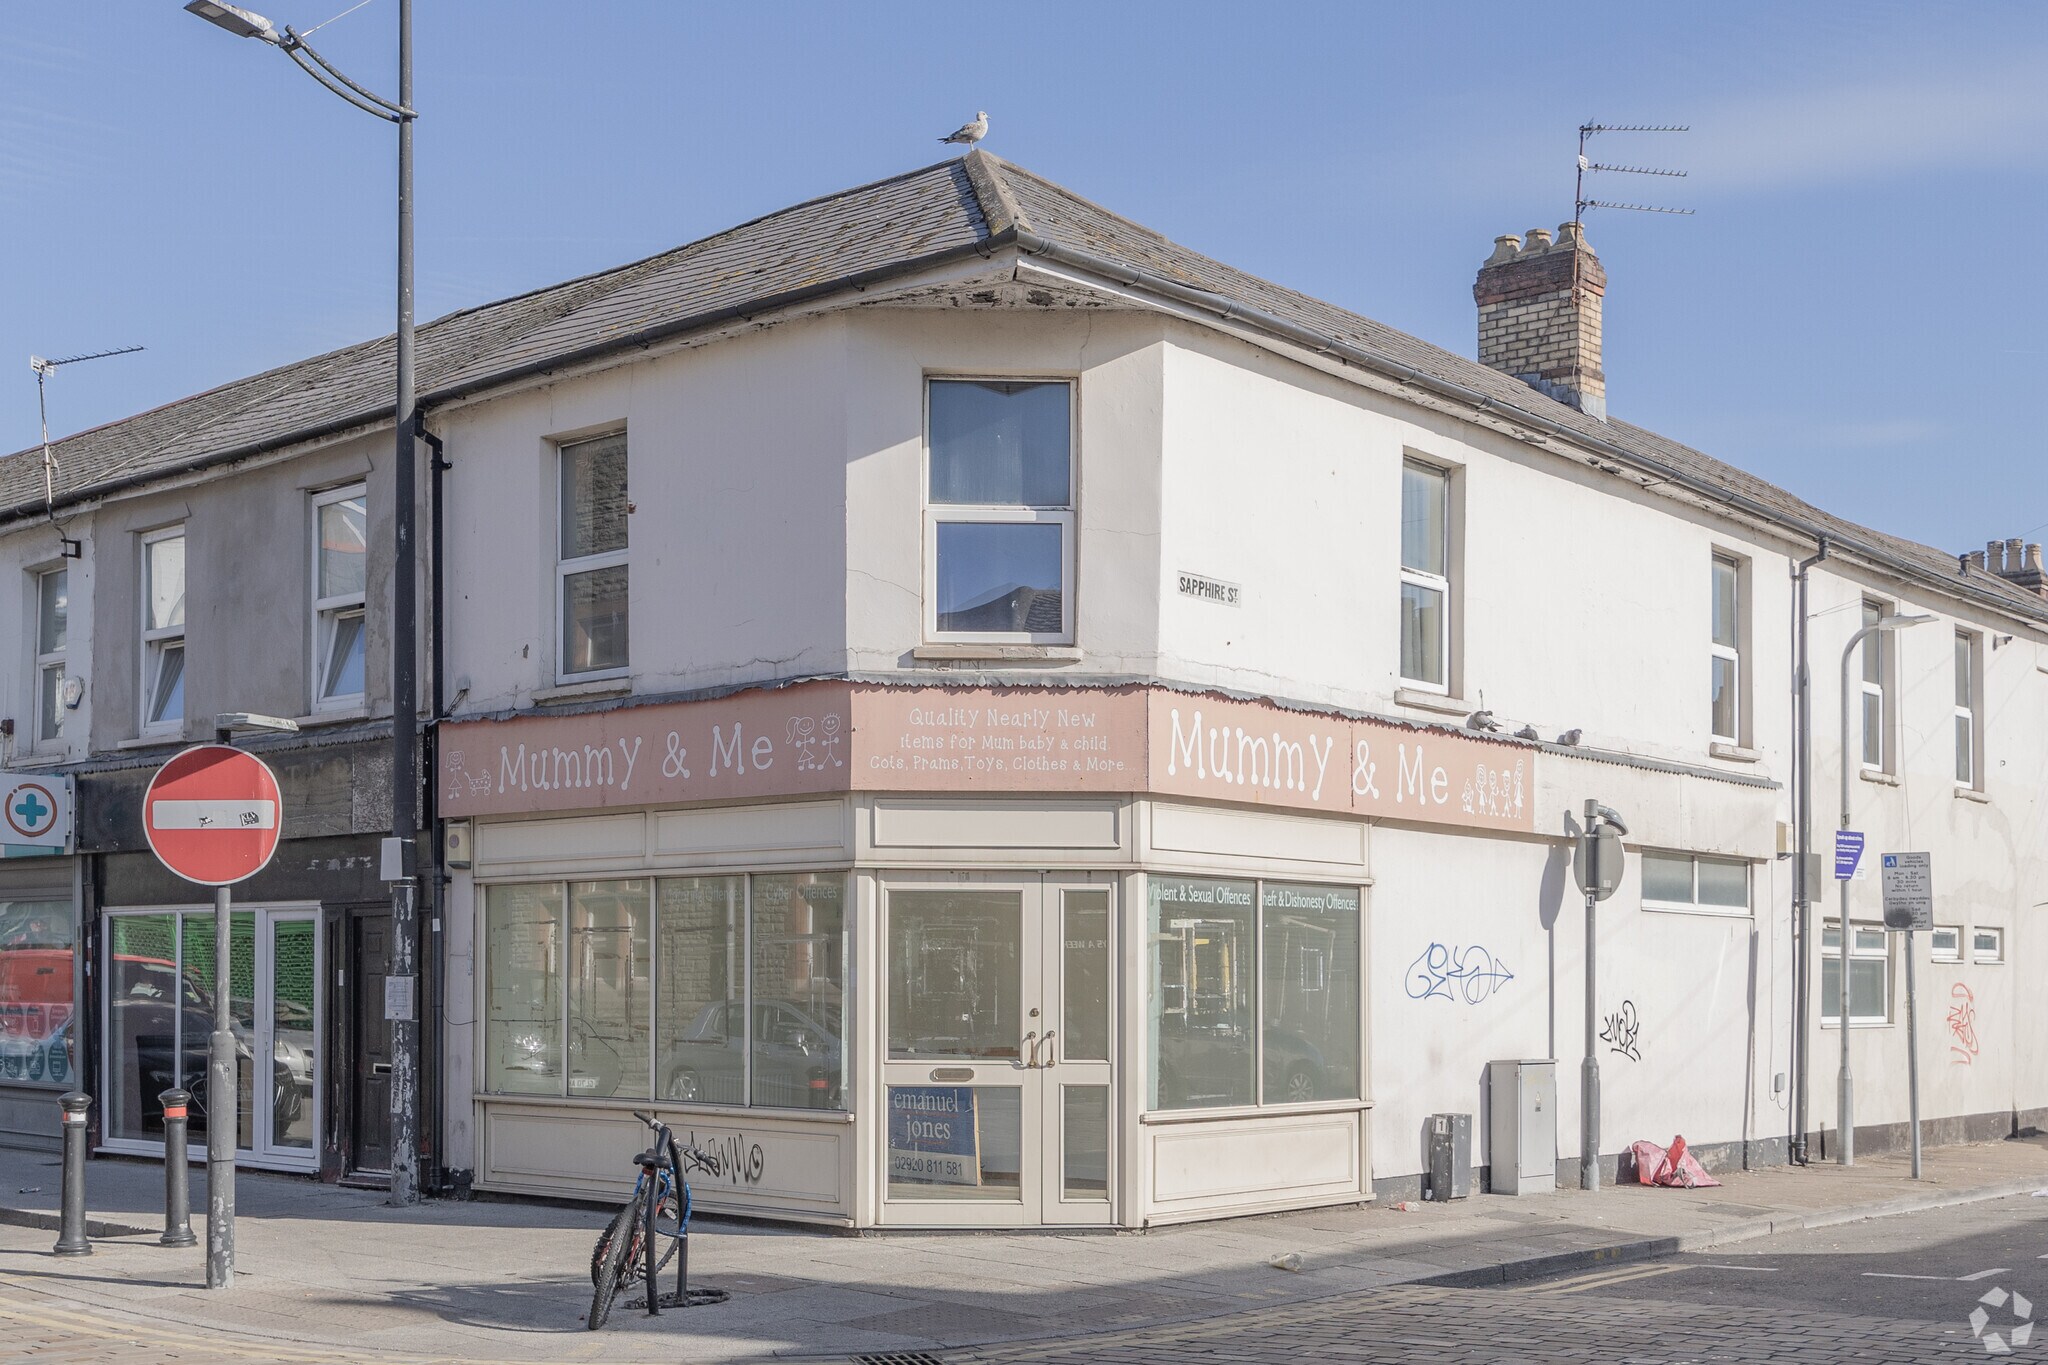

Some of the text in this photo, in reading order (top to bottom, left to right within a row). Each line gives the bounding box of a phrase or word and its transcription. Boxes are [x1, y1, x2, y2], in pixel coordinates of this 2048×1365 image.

[1180, 576, 1225, 602] SAPPHIRE
[909, 707, 1096, 729] Quality Nearly New
[950, 734, 977, 750] for
[981, 735, 1015, 750] Mum
[1019, 735, 1055, 752] baby
[1060, 739, 1069, 750] &
[498, 721, 774, 794] Mummy & Me
[1013, 756, 1068, 771] Clothes
[1073, 760, 1081, 771] &
[1167, 708, 1449, 805] Mummy & Me
[766, 882, 838, 901] Cyber Offences
[1179, 884, 1187, 902] &
[1188, 885, 1214, 903] Sexual
[1216, 886, 1251, 905] Offences
[1262, 890, 1356, 914] heft & Dishonesty Offences
[1588, 895, 1593, 906] 1
[894, 1088, 959, 1113] emanuel
[906, 1114, 951, 1144] jones
[926, 1159, 943, 1174] 811
[946, 1161, 963, 1177] 581
